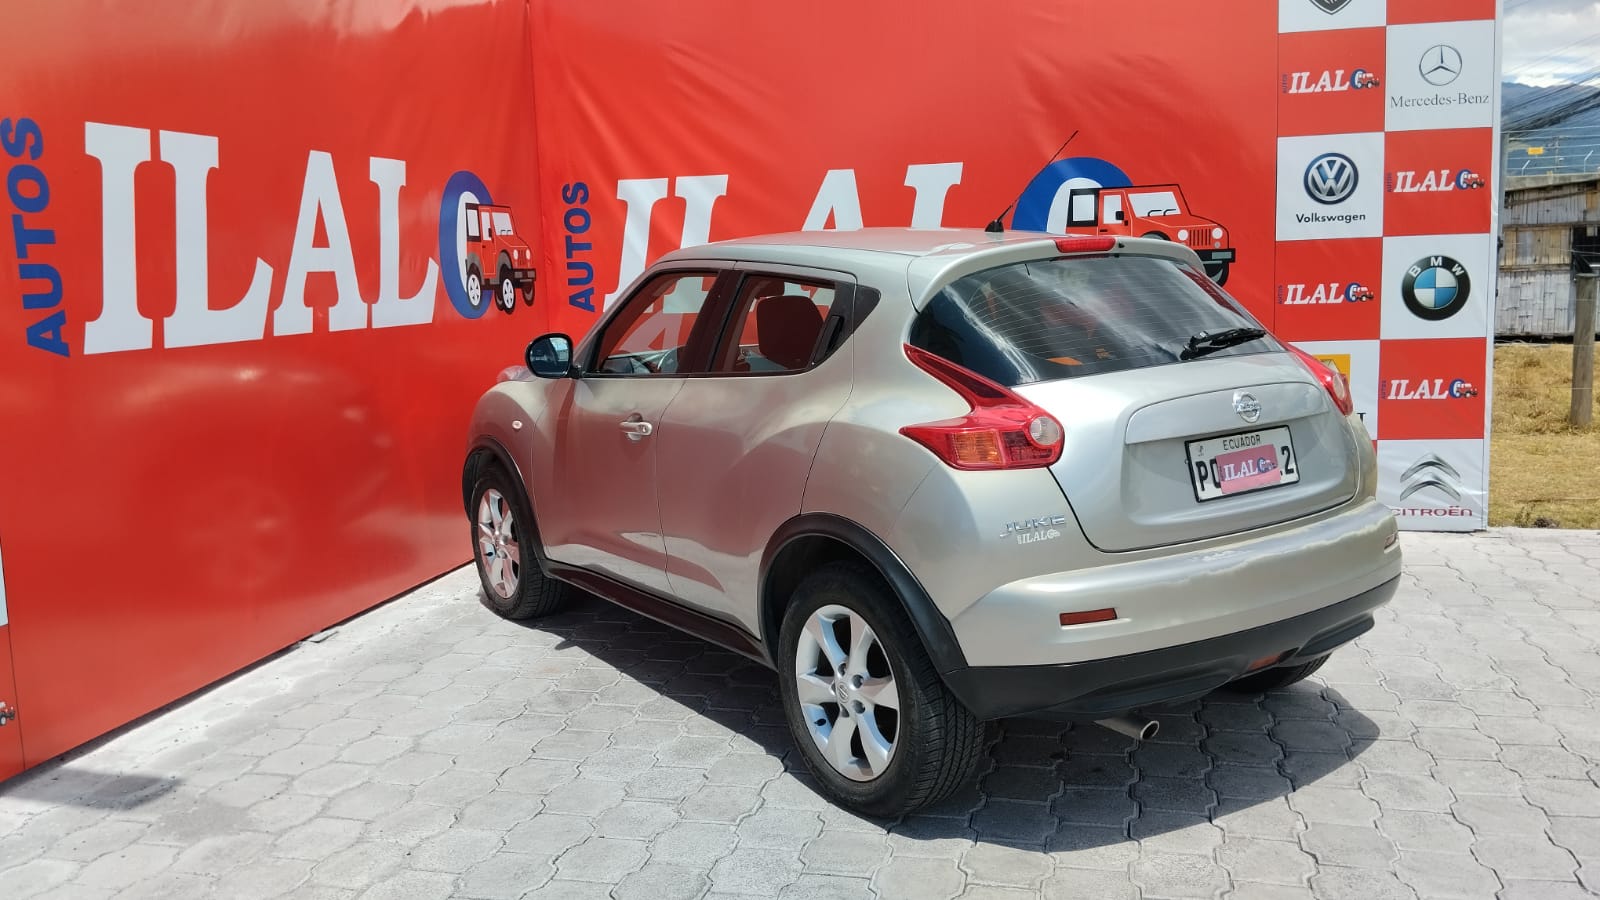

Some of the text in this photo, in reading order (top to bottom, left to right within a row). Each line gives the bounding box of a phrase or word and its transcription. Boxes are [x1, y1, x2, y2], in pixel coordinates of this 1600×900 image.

[1390, 92, 1489, 109] Mercedes-Benz
[1296, 212, 1366, 224] Volkswagen
[0, 117, 70, 358] AUTOS
[84, 121, 497, 355] ILALO
[562, 181, 595, 313] AUTOS
[1408, 256, 1465, 278] BMW
[1223, 434, 1261, 451] ECUADOR
[1391, 505, 1473, 516] CITROËN
[1000, 515, 1065, 538] JUKE
